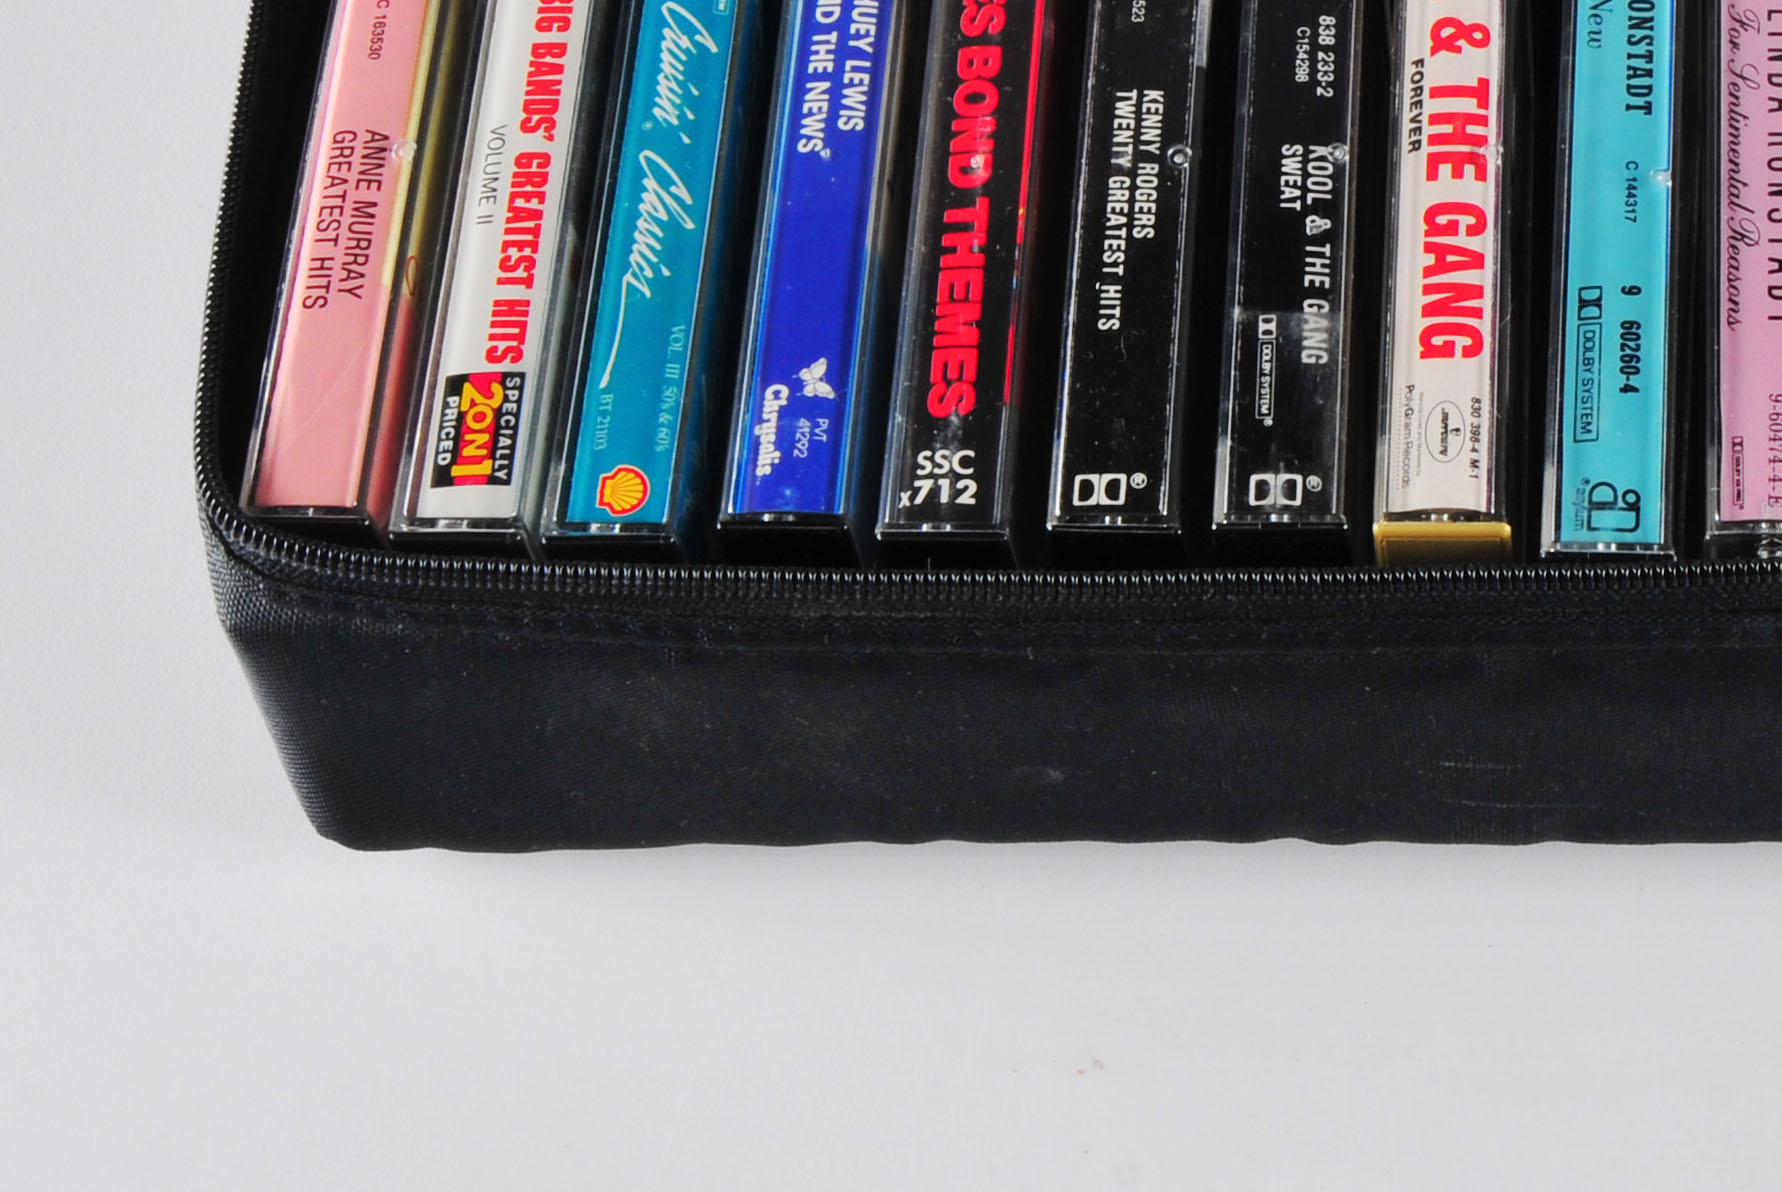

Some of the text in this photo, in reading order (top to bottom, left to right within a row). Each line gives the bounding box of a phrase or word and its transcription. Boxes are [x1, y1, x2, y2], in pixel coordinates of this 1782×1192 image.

[368, 13, 387, 61] 163530
[807, 31, 838, 74] THE
[1295, 27, 1310, 83] C154298
[1316, 15, 1337, 98] 838 233-2
[1429, 16, 1491, 57] &
[518, 41, 568, 142] BANDS'
[797, 81, 831, 154] NEWS
[837, 60, 872, 131] LEWIS
[947, 45, 1003, 190] BOND
[1407, 57, 1425, 154] FOREVER
[1424, 77, 1490, 183] THE
[475, 124, 508, 225] VOLUME II
[1132, 89, 1165, 240] KENNY ROGERS
[1279, 143, 1304, 212] SWEAT
[1623, 160, 1639, 223] C 144317
[1727, 4, 1760, 332] For Sentimental Reasons
[302, 130, 358, 310] GREATEST HITS
[336, 129, 390, 299] ANNE MURRAY
[495, 151, 552, 290] GREATEST
[1097, 89, 1138, 332] TWENTY GREATEST HITS
[1300, 144, 1334, 365] KOOL & THE GANG
[926, 195, 990, 418] THEMES
[1418, 201, 1488, 360] GANG
[485, 298, 531, 365] HITS
[667, 324, 687, 360] VOL.
[1619, 285, 1642, 394] 9 60260-4
[594, 394, 614, 451] BT 21103
[1258, 344, 1272, 415] DOLBY SYSTEM
[1470, 396, 1482, 418] 830
[1580, 329, 1596, 435] DOLBY SYSTEM
[437, 395, 460, 466] PRICED
[493, 377, 522, 481] SPECIALLY
[754, 383, 789, 477] Chrysalis
[793, 418, 811, 458] 41292
[812, 417, 829, 443] PVT
[916, 450, 976, 475] SSC
[1401, 383, 1416, 489] PolyGram Records
[1469, 422, 1481, 453] 398-4
